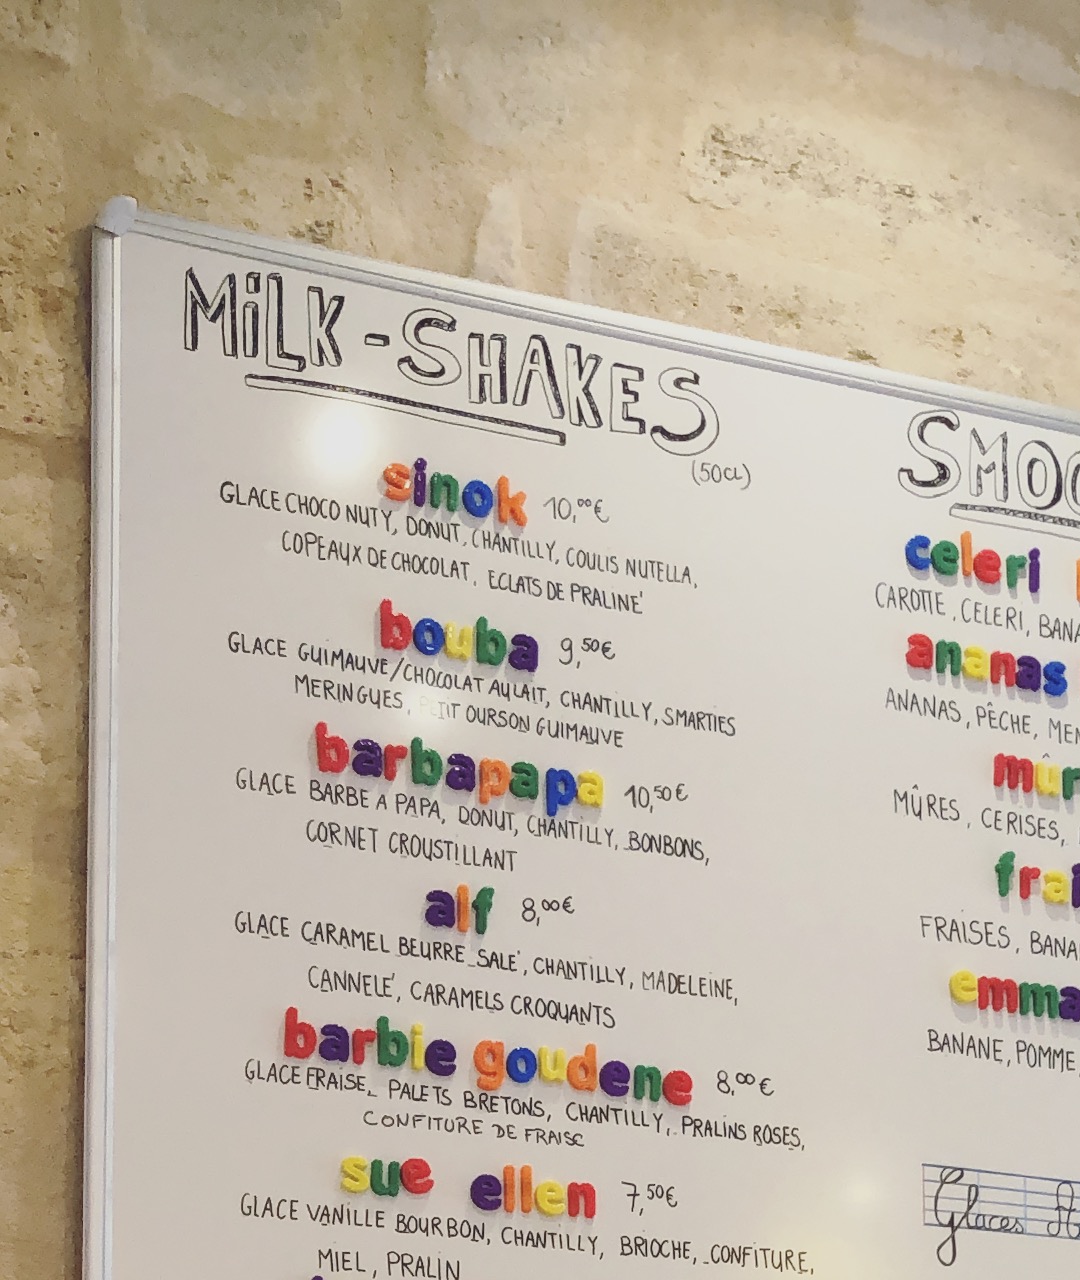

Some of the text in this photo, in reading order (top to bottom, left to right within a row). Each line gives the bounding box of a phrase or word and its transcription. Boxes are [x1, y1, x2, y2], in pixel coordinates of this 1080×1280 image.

[383, 457, 528, 527] sinok
[219, 480, 281, 511] GLACE
[284, 492, 341, 520] CHOCO
[472, 529, 560, 564] CHANTILLY,
[566, 548, 619, 574] COULIS
[626, 559, 698, 588] NUTELLA,
[282, 530, 565, 601] COPEAUX DE ECLATS DE
[905, 530, 1040, 593] celeri
[380, 599, 538, 672] bouba
[906, 633, 1068, 697] ananas
[228, 632, 736, 736] GLACE CHANTILLY, SMARTIES
[466, 705, 530, 732] OURSON
[536, 718, 624, 748] GUIMAUVE
[236, 767, 297, 795] GLACE
[309, 779, 369, 808] BARBE
[315, 721, 604, 817] barbapapa
[306, 819, 517, 871] CORNET CROUSTILLANT
[424, 884, 495, 934] alf
[234, 911, 289, 938] GLACE
[301, 921, 390, 953] CARAMEL
[398, 936, 465, 963] BEURRE
[533, 956, 635, 989] CHANTILLY,
[410, 981, 615, 1028] CARAMELS CROQUANTS
[283, 1007, 693, 1106] barbie goudene
[245, 1059, 301, 1084] GLACE
[681, 1115, 747, 1141] PRALINS
[363, 1111, 518, 1139] CONFITURE DE
[240, 1192, 299, 1220] GLACE
[306, 1202, 385, 1228] VANILLE
[395, 1214, 491, 1245] BOURBON,
[340, 1156, 596, 1219] sue ellen
[387, 1251, 460, 1280] PRALIN
